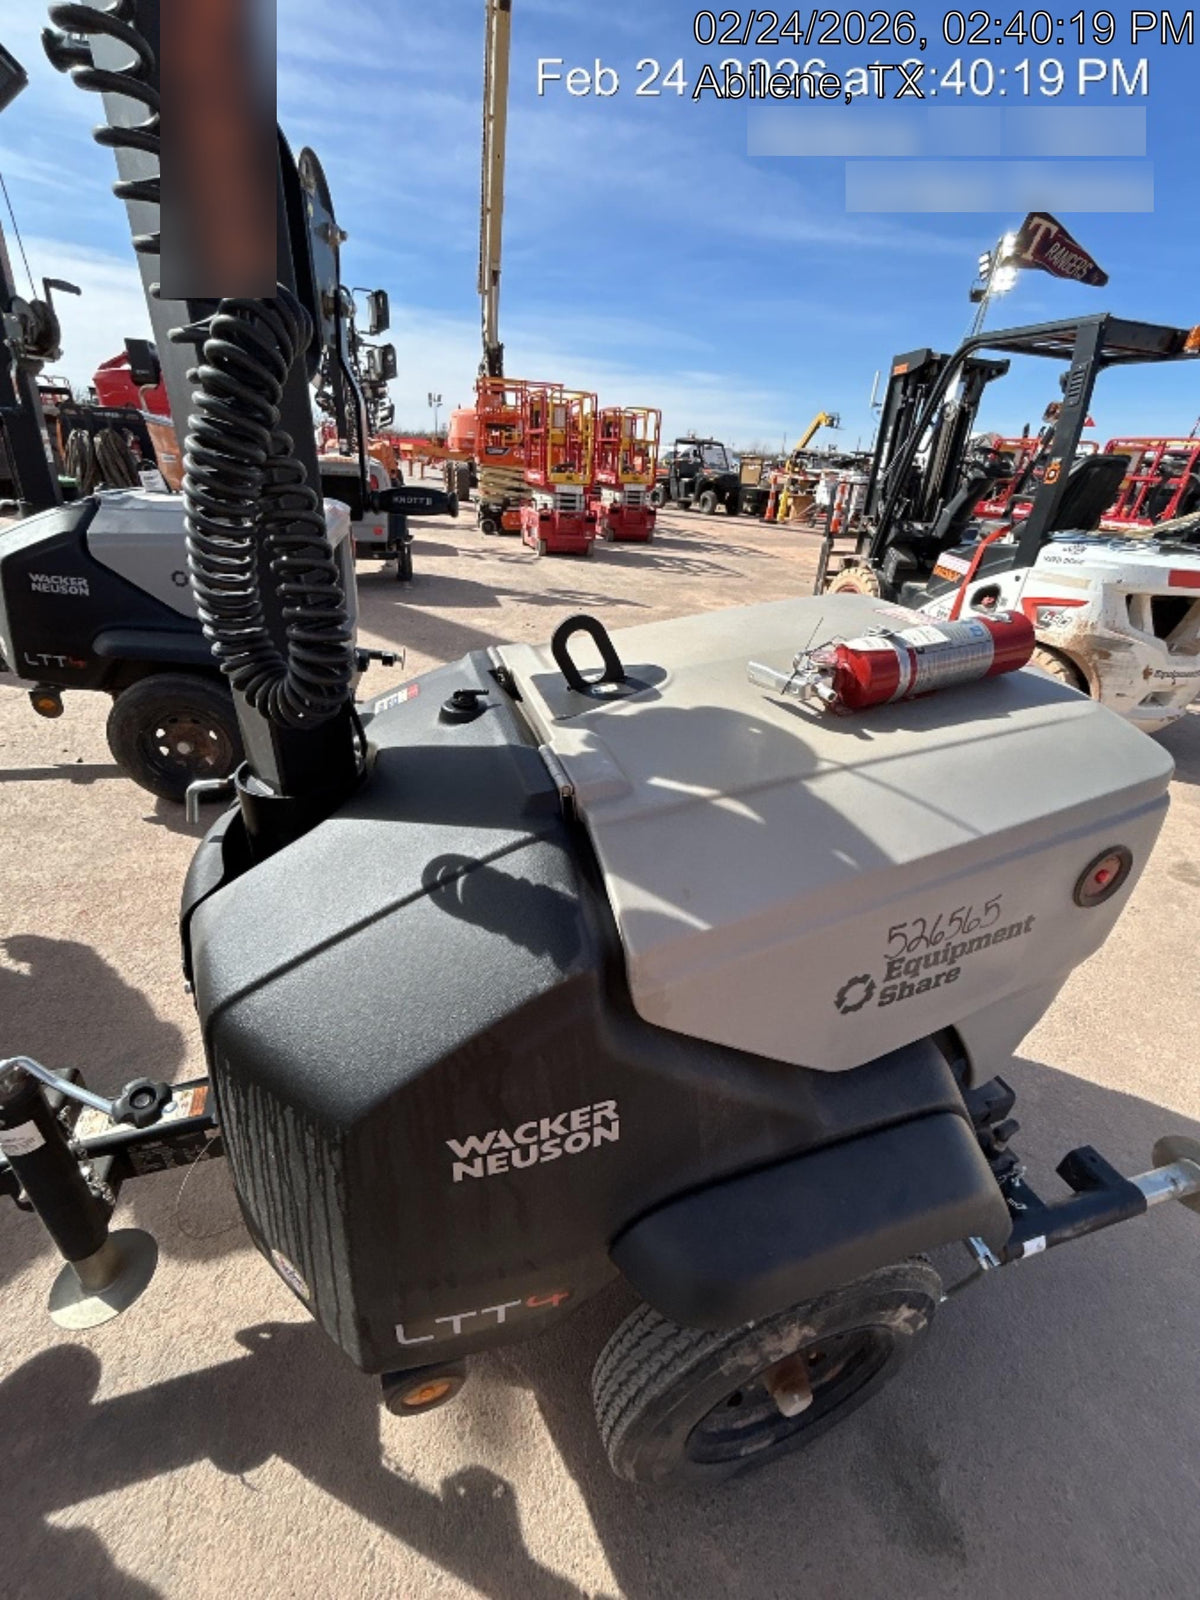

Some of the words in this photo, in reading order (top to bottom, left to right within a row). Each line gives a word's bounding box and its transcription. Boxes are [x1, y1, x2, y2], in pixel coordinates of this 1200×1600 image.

[1020, 216, 1059, 260] T
[28, 572, 88, 588] WACKER
[31, 582, 90, 597] NEUSON
[883, 914, 1036, 983] Equipment
[884, 894, 1002, 959] 526565
[877, 966, 961, 1007] Share
[445, 1099, 620, 1159] WACKER
[453, 1119, 620, 1183] NEUSON
[395, 1293, 569, 1345] LTT4
